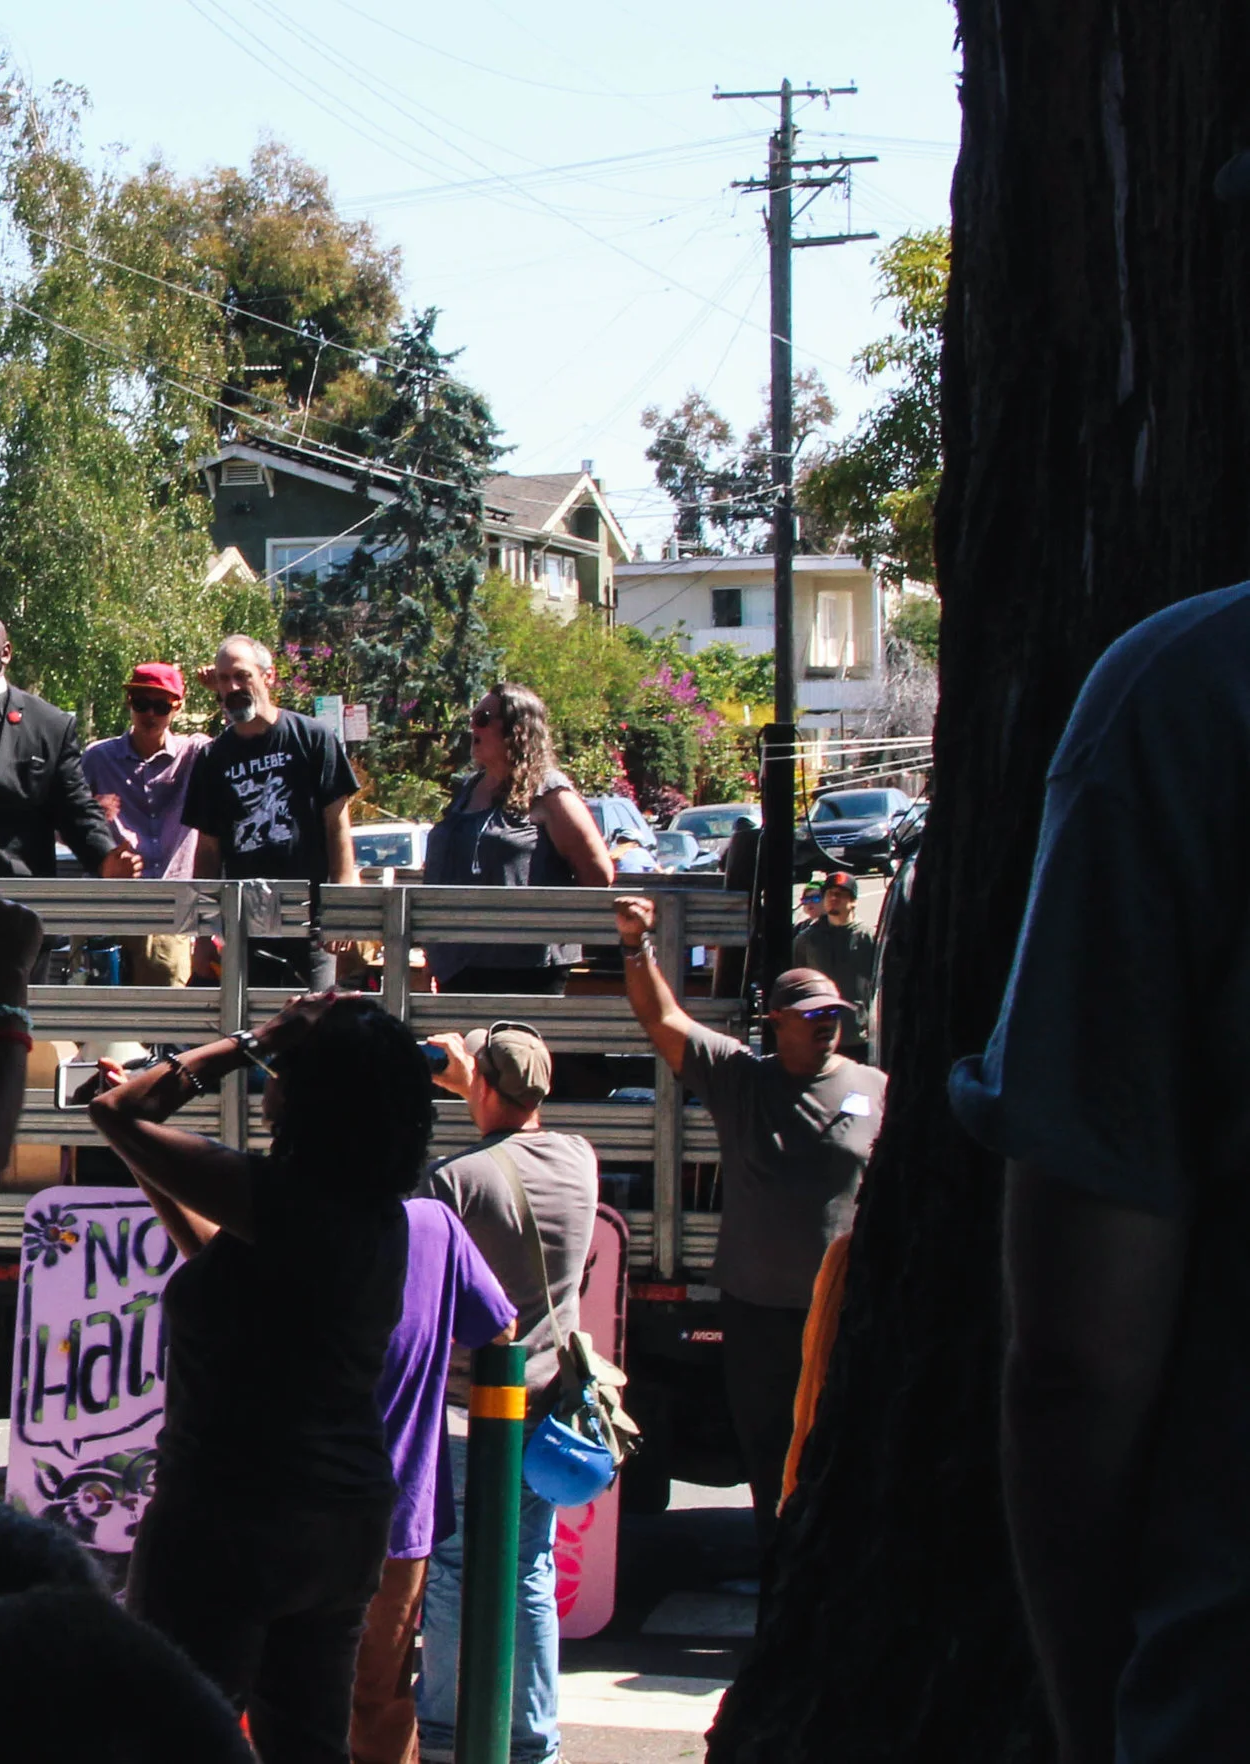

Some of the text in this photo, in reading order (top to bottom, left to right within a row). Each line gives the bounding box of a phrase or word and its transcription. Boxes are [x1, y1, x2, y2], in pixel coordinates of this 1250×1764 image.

[231, 752, 286, 779] LA PLEBE
[85, 1216, 178, 1299] NO
